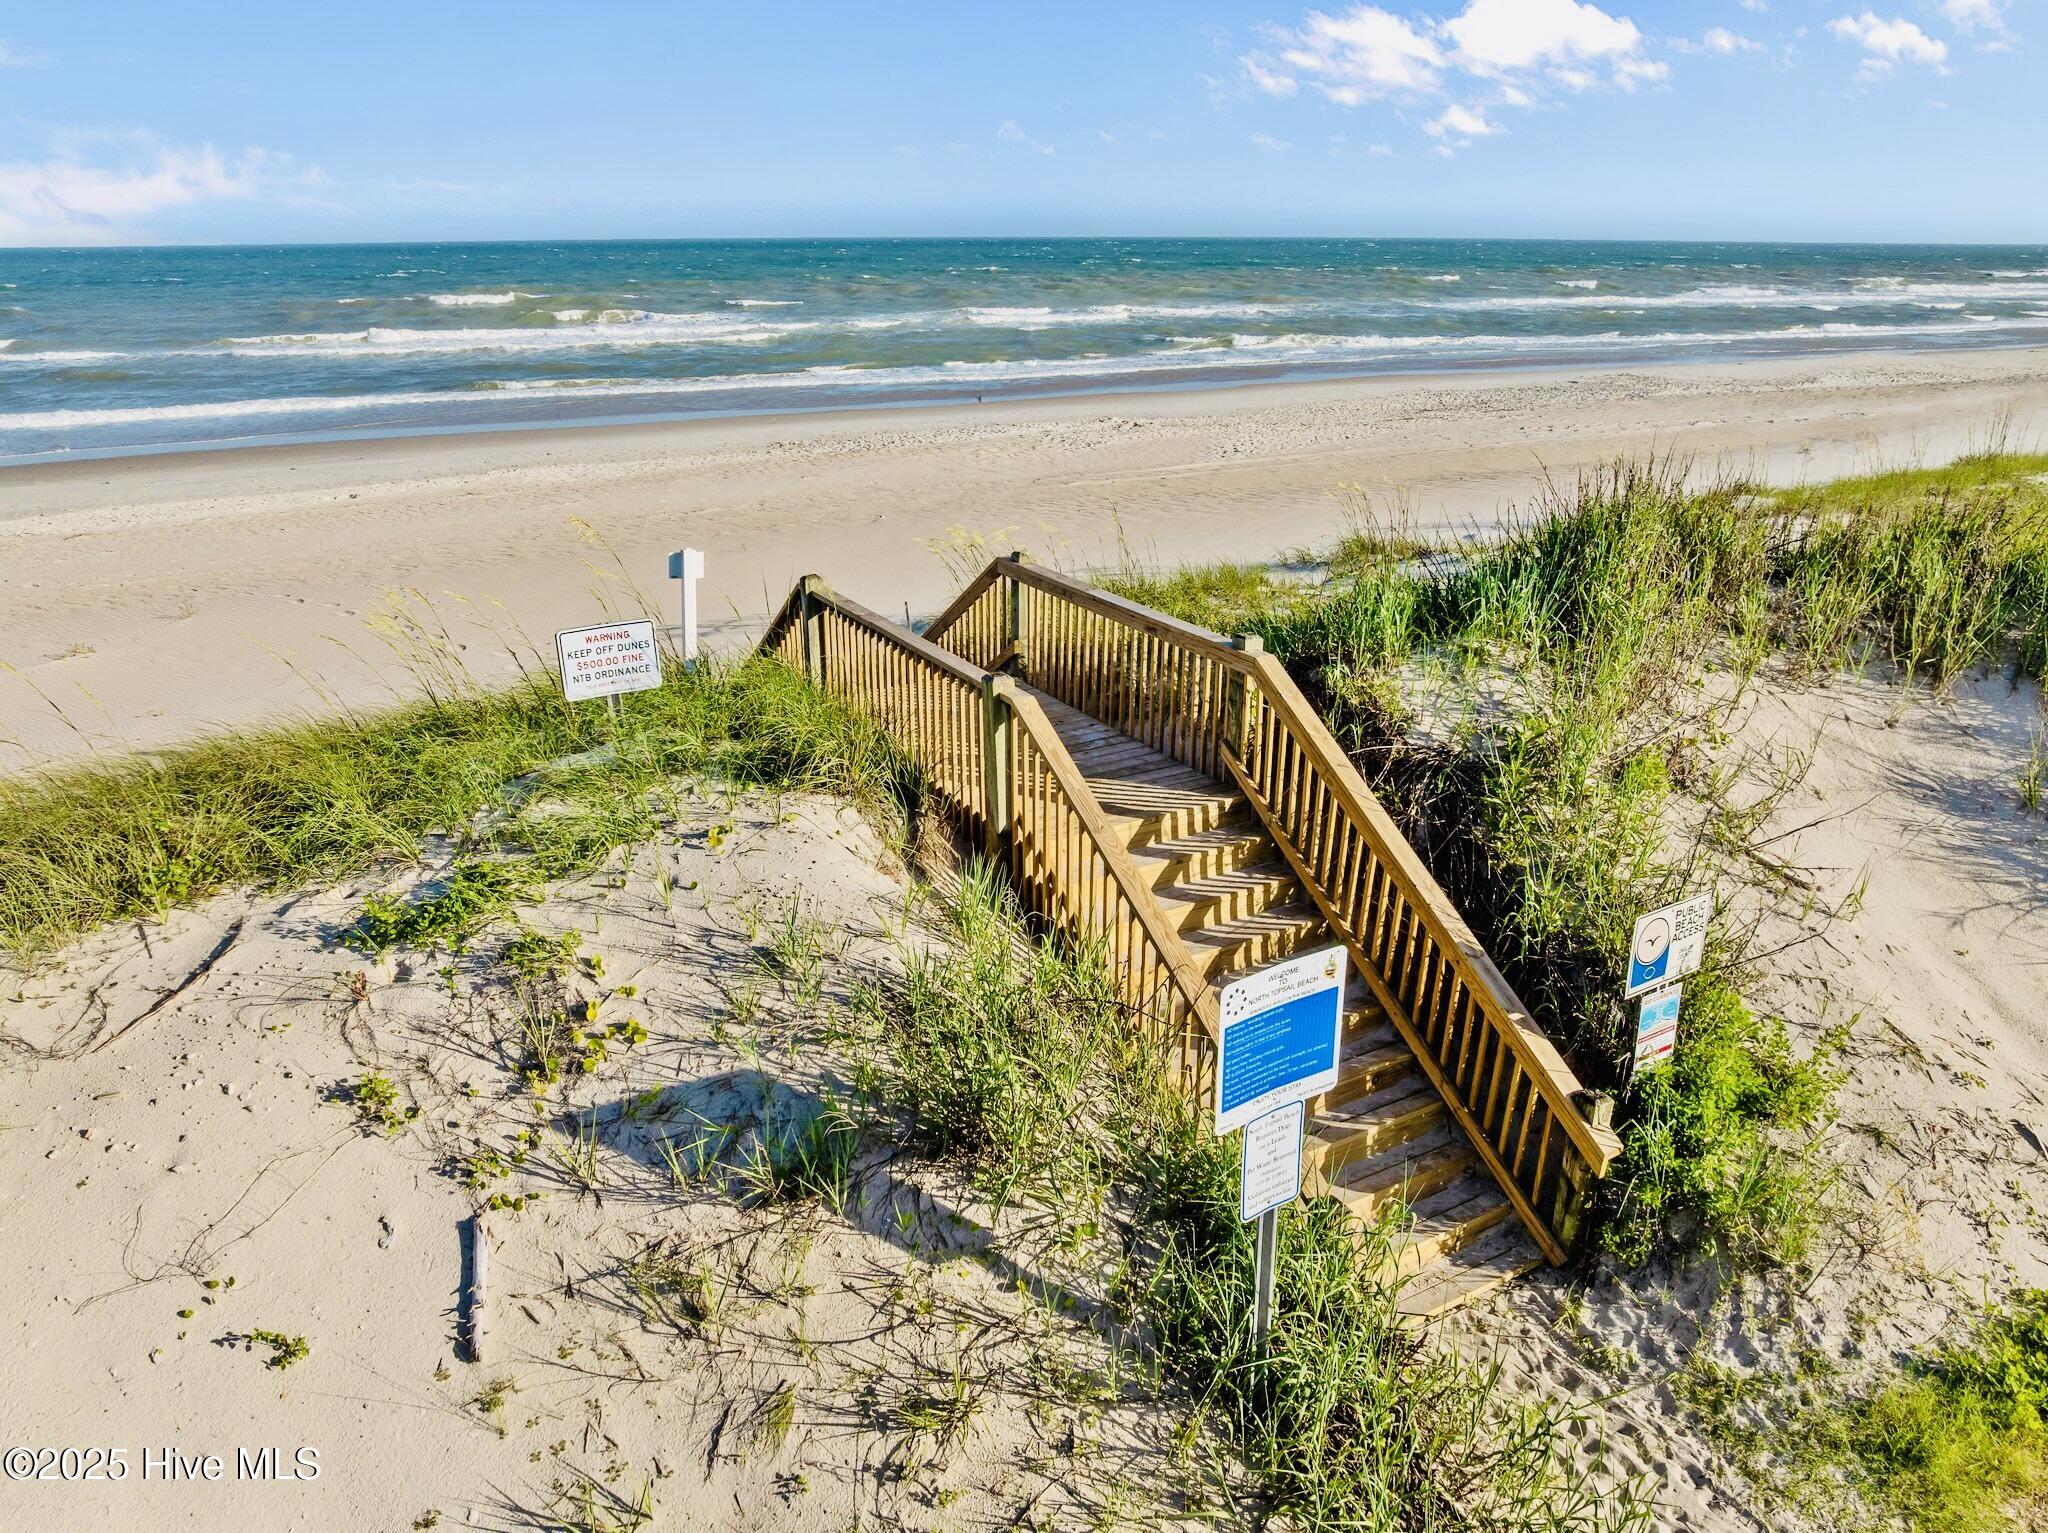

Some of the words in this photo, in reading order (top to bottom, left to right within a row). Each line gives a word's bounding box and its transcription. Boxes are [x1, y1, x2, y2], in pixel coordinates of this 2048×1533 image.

[584, 631, 630, 644] WARNING
[567, 648, 592, 660] KEEP
[595, 644, 614, 655] OFF
[617, 640, 650, 652] DUNES
[622, 653, 645, 664] FINE
[572, 673, 592, 684] NTB
[595, 664, 652, 680] ORDINANCE
[1675, 900, 1707, 920] PUBLIC
[1674, 911, 1705, 932] BEACH
[1672, 922, 1704, 943] ACCESS
[1268, 967, 1300, 982] WELCOME
[1279, 978, 1288, 986] TO
[1248, 992, 1270, 1006] NORTH
[1271, 984, 1296, 998] TOPSAIL
[1297, 976, 1319, 988] BEACH
[1289, 1082, 1302, 1090] STAY
